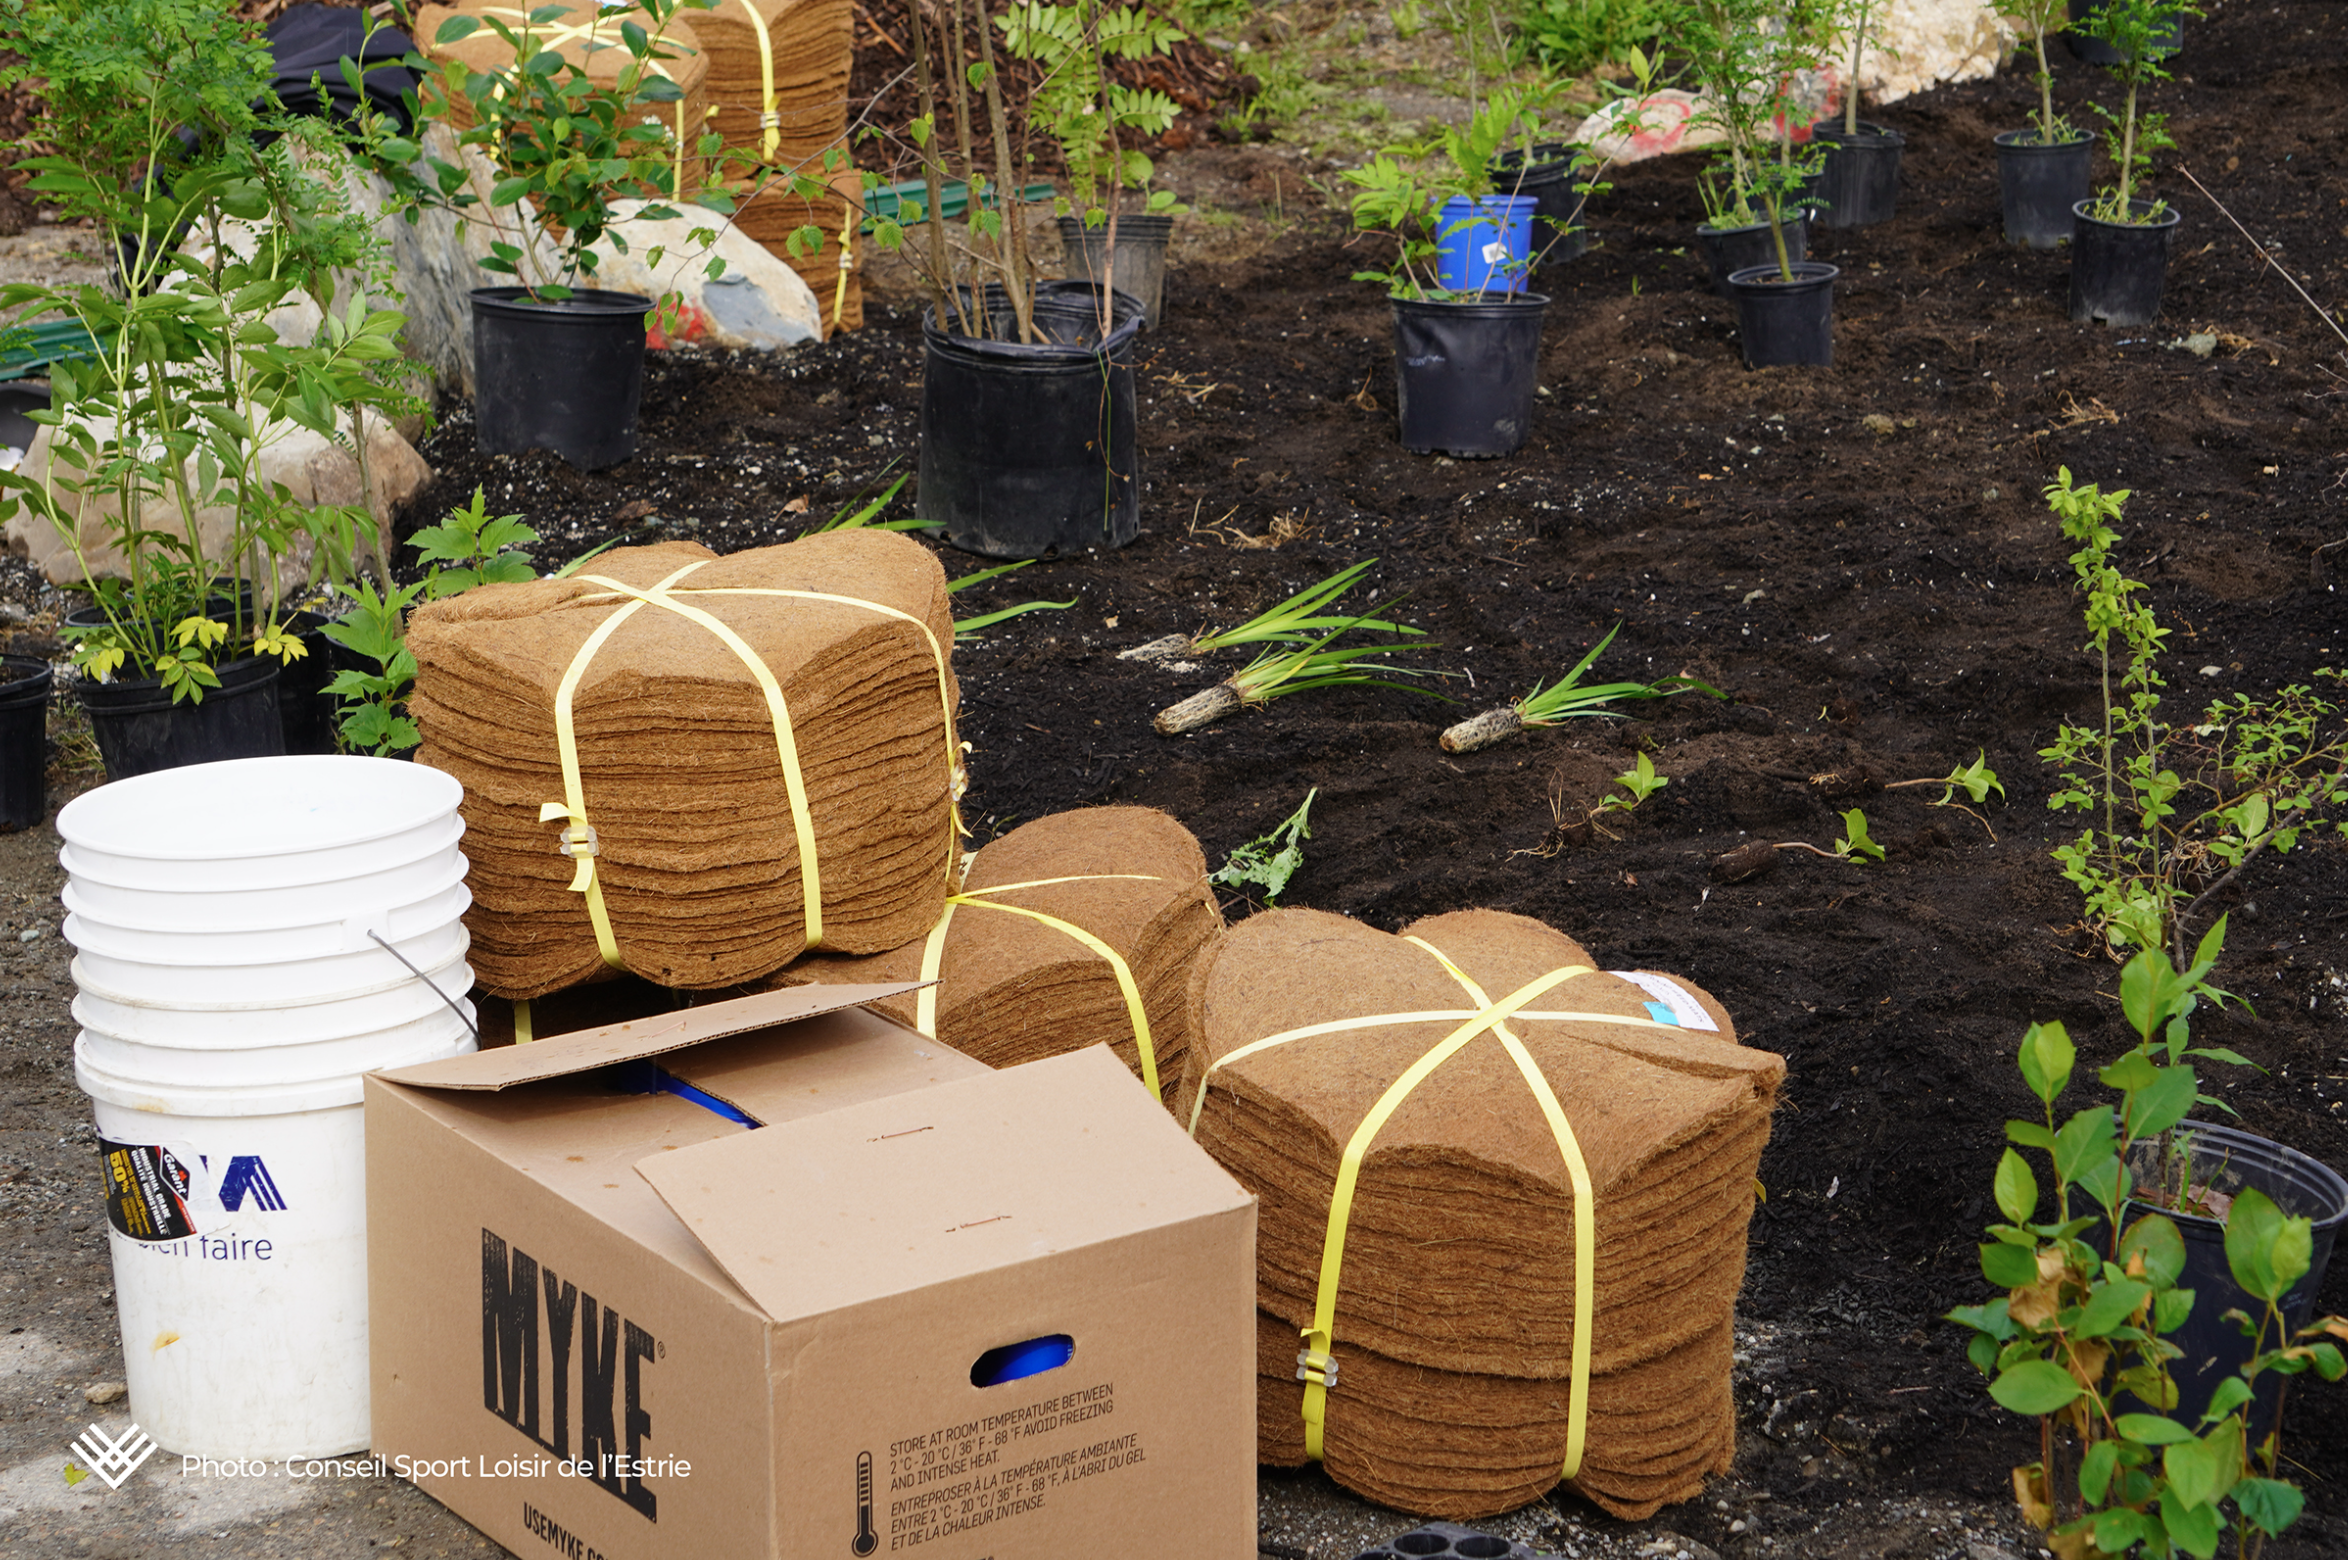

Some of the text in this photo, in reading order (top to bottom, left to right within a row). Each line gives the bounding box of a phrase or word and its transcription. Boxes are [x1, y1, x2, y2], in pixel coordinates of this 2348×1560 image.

[109, 1151, 130, 1193] 50%
[139, 1147, 171, 1219] INDUSTRIAL GRADE
[164, 1154, 187, 1194] Garant
[142, 1182, 168, 1235] INDUSTRIELLE
[199, 1232, 272, 1260] faire
[890, 1383, 1113, 1458] STORE AT ROOM TEMPERATURE BETWEEN
[890, 1460, 897, 1475] 2
[922, 1450, 935, 1466] 20
[995, 1430, 1008, 1445] 68
[1023, 1416, 1057, 1438] AVOID
[1060, 1399, 1113, 1427] FREEZING
[891, 1449, 1000, 1493] AND INTENSE HEAT.
[891, 1433, 1137, 1517] ENTREPROSER À LA TEMPÉRATURE AMBIANTE
[891, 1510, 929, 1534] ENTRE
[930, 1508, 937, 1523] 2
[961, 1498, 974, 1514] 20
[1032, 1476, 1045, 1492] 68
[1062, 1465, 1070, 1483] À
[1072, 1458, 1106, 1480] L'ABRI
[1108, 1453, 1124, 1470] DU
[1126, 1448, 1146, 1466] GEL
[891, 1493, 1045, 1551] ET DE LA CHALEUR INTENSE.
